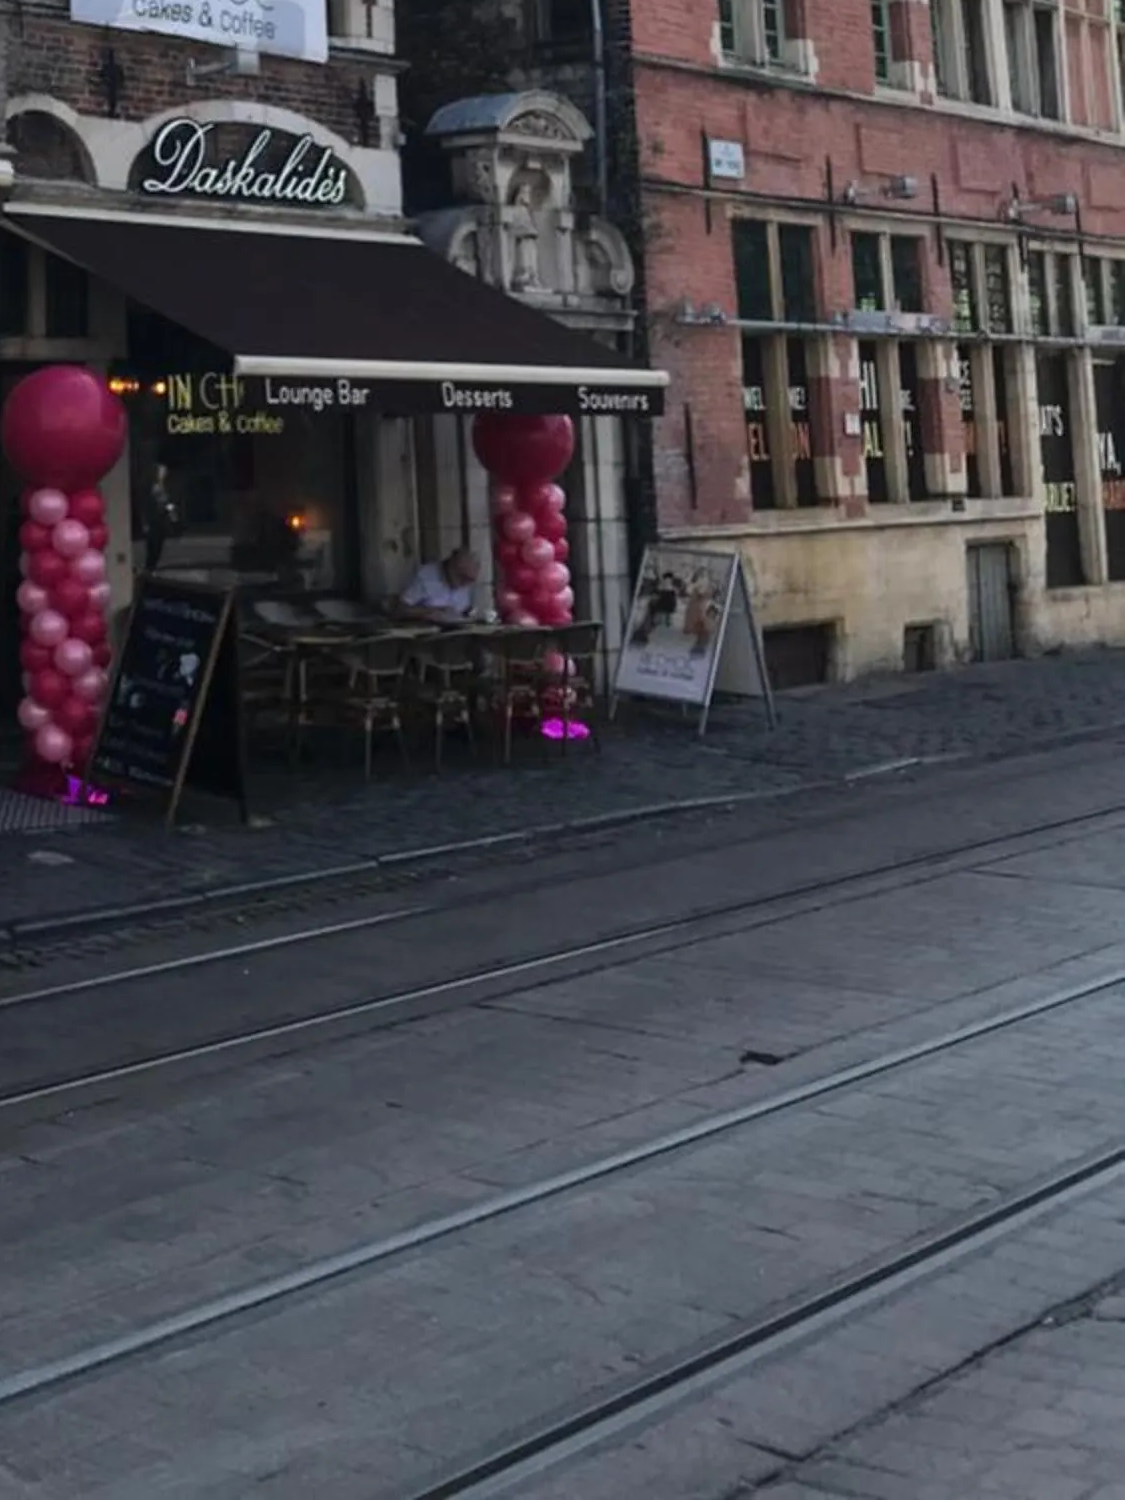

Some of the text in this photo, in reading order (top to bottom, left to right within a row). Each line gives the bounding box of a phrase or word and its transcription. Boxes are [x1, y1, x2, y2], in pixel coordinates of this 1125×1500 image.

[198, 0, 214, 28] &
[167, 370, 245, 410] IN CH
[264, 376, 371, 412] Lounge Bar
[441, 381, 514, 408] Desserts
[577, 385, 650, 412] Souvenirs
[218, 409, 233, 434] &
